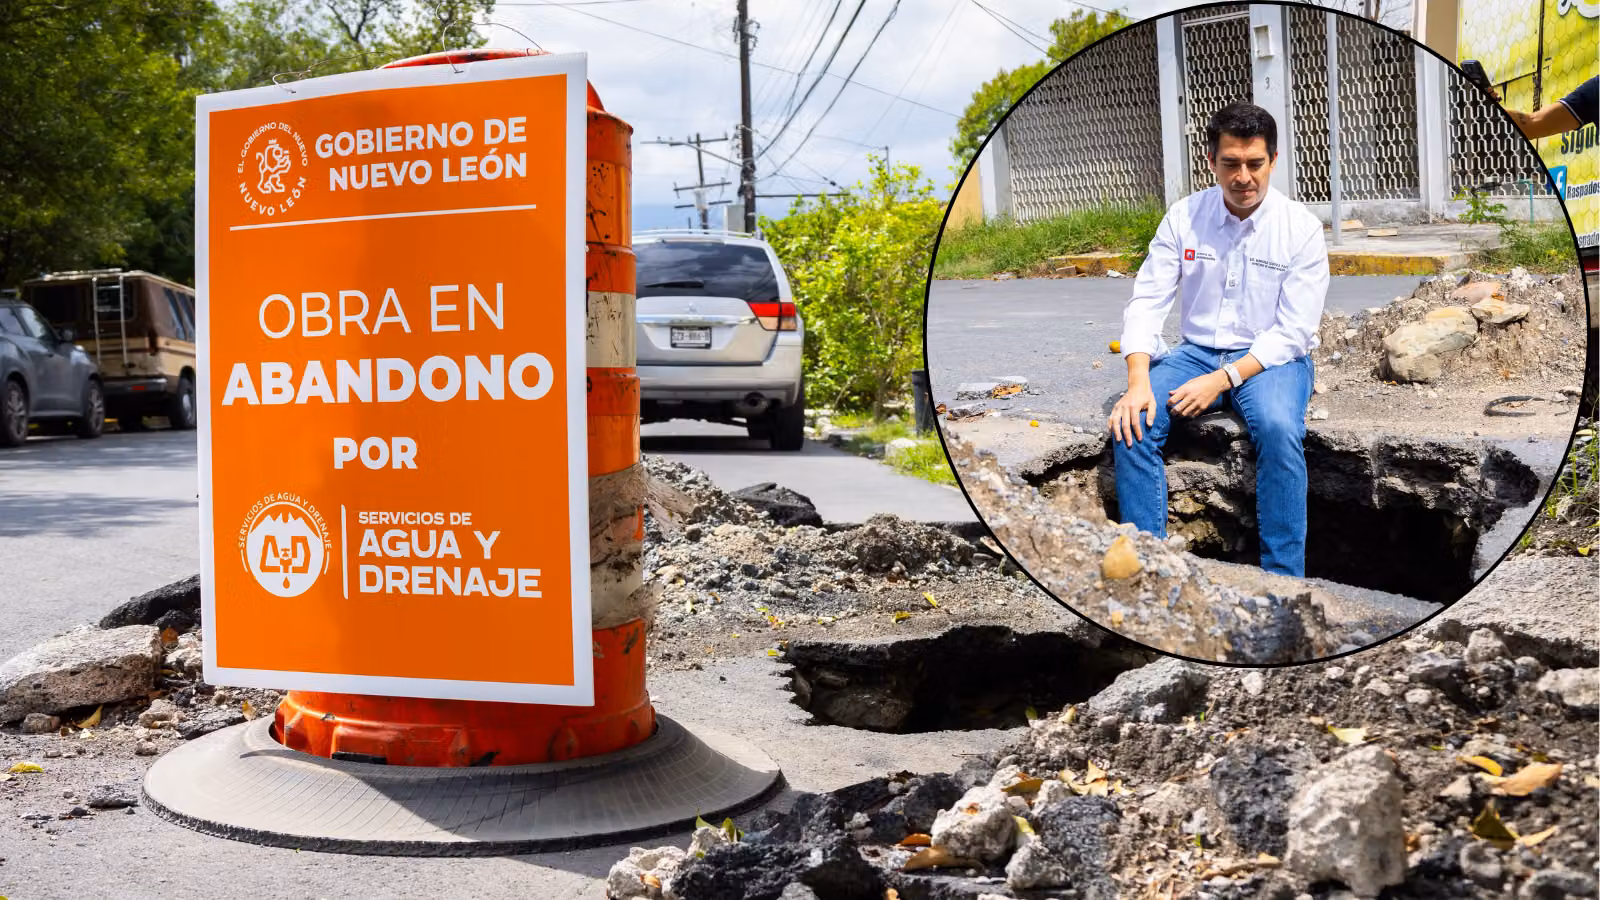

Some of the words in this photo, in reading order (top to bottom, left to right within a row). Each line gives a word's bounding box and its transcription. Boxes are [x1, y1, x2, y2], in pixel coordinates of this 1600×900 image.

[240, 121, 277, 158] GOBIERNO
[278, 121, 293, 135] DEL
[315, 121, 474, 159] GOBIERNO
[484, 116, 527, 145] DE
[237, 160, 245, 174] EL
[292, 131, 308, 167] NUEVO
[329, 159, 433, 192] NUEVO
[442, 147, 527, 182] LEÓN
[239, 181, 276, 217] NUEVO
[279, 176, 307, 214] LEÓN
[258, 287, 412, 339] OBRA
[429, 282, 504, 333] EN
[221, 352, 554, 406] ABANDONO
[333, 436, 419, 470] POR
[238, 500, 264, 549] SERVICIOS
[263, 493, 276, 505] DE
[277, 491, 302, 505] AGUA
[302, 498, 309, 508] Y
[308, 505, 333, 549] DRENAJE
[358, 511, 445, 526] SERVICIOS
[450, 511, 473, 526] DE
[358, 528, 462, 559] AGUA
[473, 530, 501, 560] Y
[359, 564, 542, 599] DRENAJE
